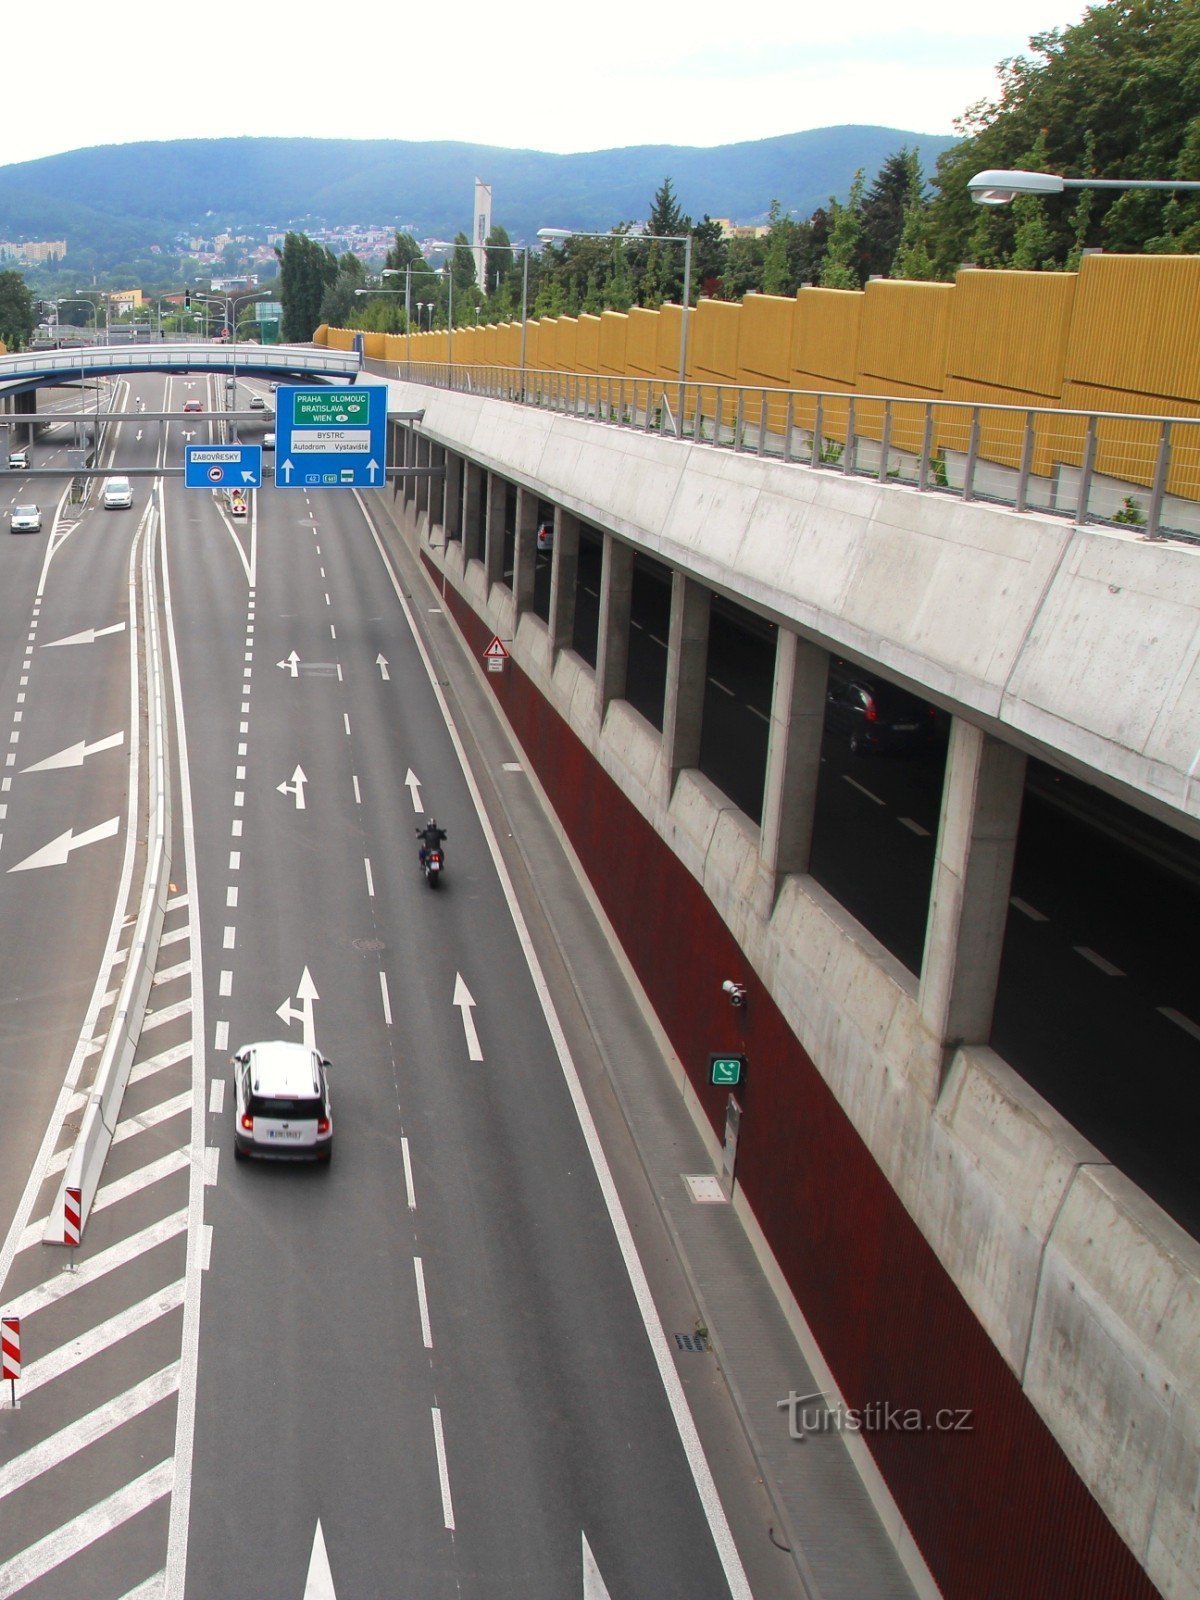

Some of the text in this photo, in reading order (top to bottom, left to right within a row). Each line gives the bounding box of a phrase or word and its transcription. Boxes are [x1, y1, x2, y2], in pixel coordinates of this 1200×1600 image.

[297, 395, 366, 403] PRAHA OLOMOUC
[301, 405, 344, 413] BRATISLAVA
[312, 414, 332, 422] WIEN
[293, 443, 326, 451] Autodrom
